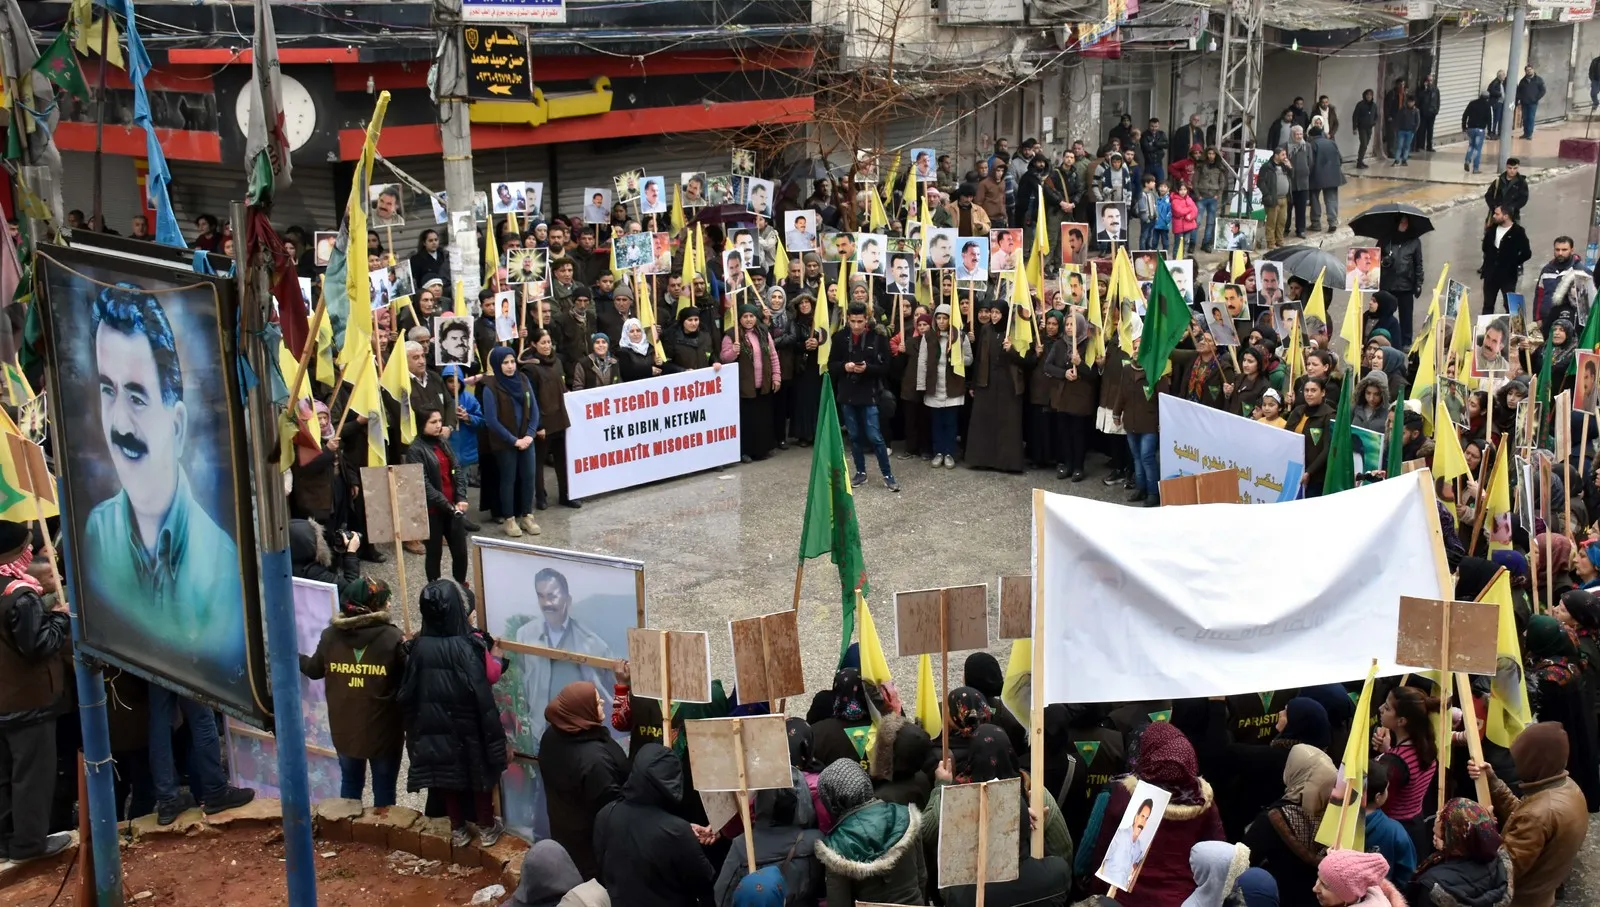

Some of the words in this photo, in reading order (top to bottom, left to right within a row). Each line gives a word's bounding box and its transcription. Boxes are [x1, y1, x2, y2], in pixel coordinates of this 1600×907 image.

[484, 30, 519, 51] لمحامي
[471, 53, 489, 65] محمد
[489, 53, 508, 69] حميد
[506, 53, 525, 69] حسن
[585, 397, 611, 420] EMÊ
[613, 389, 659, 415] TECRÎD
[673, 376, 722, 402] FAŞÎZMÊ
[603, 424, 624, 442] TÊK
[628, 417, 663, 437] BIBIN,
[664, 408, 706, 430] NETEWA
[574, 442, 650, 474] DEMOKRATÎK
[653, 431, 703, 457] MISOGER
[706, 424, 737, 444] BIKIN
[1173, 440, 1199, 463] الفاشية
[329, 662, 387, 676] PARASTINA
[348, 677, 364, 688] JIN
[1238, 712, 1280, 729] PARASTI
[1257, 726, 1272, 739] JIN
